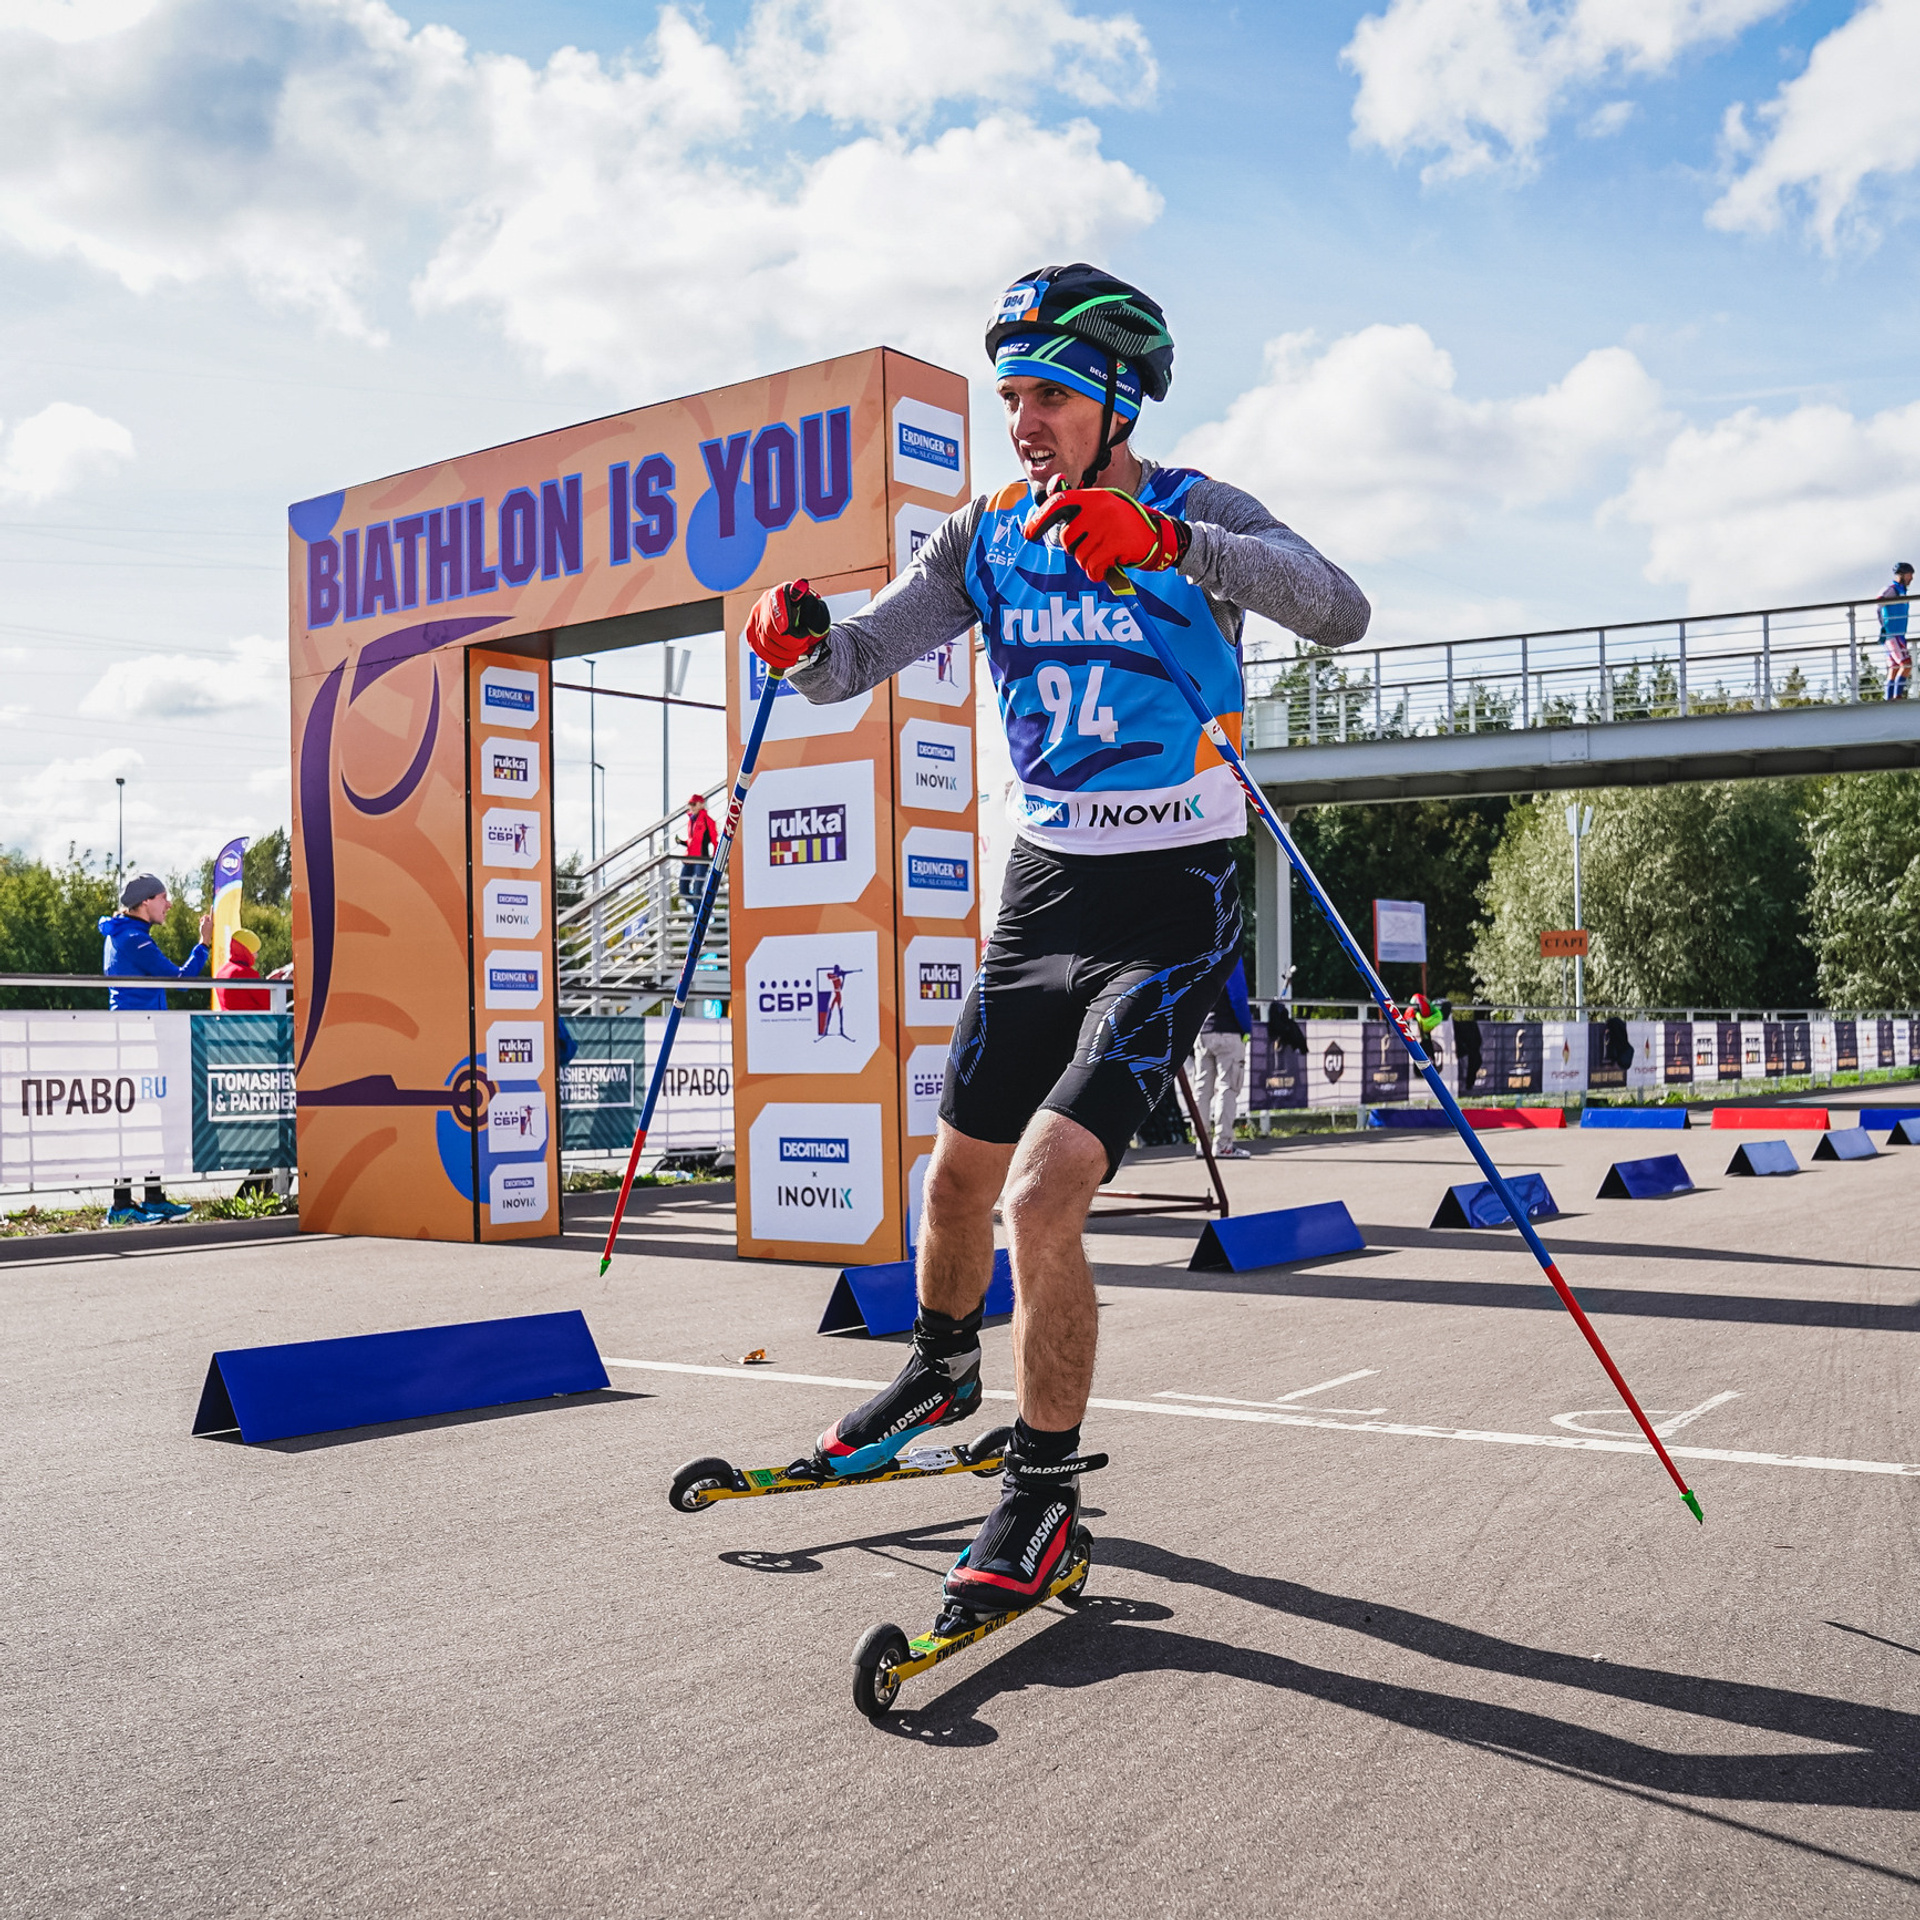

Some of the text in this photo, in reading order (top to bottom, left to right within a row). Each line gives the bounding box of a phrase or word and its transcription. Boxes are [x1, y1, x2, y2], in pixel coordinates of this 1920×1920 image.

[1003, 294, 1026, 308] 094
[902, 428, 946, 456] ERDINGER
[306, 405, 852, 629] BIATHLON IS YOU
[1002, 595, 1144, 644] rukka
[487, 686, 524, 702] ERDINGER
[1036, 664, 1119, 744] 94
[493, 757, 526, 770] rukka
[915, 772, 957, 791] INOVIK
[1089, 794, 1205, 828] INOVIK
[770, 808, 843, 838] rukka
[488, 831, 514, 842] СБР
[911, 862, 956, 879] ERDINGER
[496, 914, 530, 925] INOVIK
[1544, 937, 1583, 948] СТАРТ
[492, 970, 528, 983] ERDINGER
[920, 964, 960, 981] rukka
[758, 992, 814, 1013] СБР
[500, 1040, 531, 1052] rukka
[1325, 1054, 1342, 1072] GU
[662, 1068, 730, 1096] ПРАВО
[914, 1083, 942, 1095] СБР
[21, 1076, 167, 1116] ПРАВО RU
[215, 1093, 227, 1112] &
[494, 1116, 519, 1127] СБР
[783, 1142, 846, 1158] DECATHLON
[502, 1197, 536, 1209] INOVIK
[777, 1186, 853, 1209] INOVIK
[1019, 1461, 1088, 1474] MADSHUS
[763, 1481, 824, 1496] SWENOR
[888, 1468, 946, 1481] SWENOR
[1019, 1502, 1068, 1577] MADSHUS
[935, 1631, 976, 1663] SWENOR
